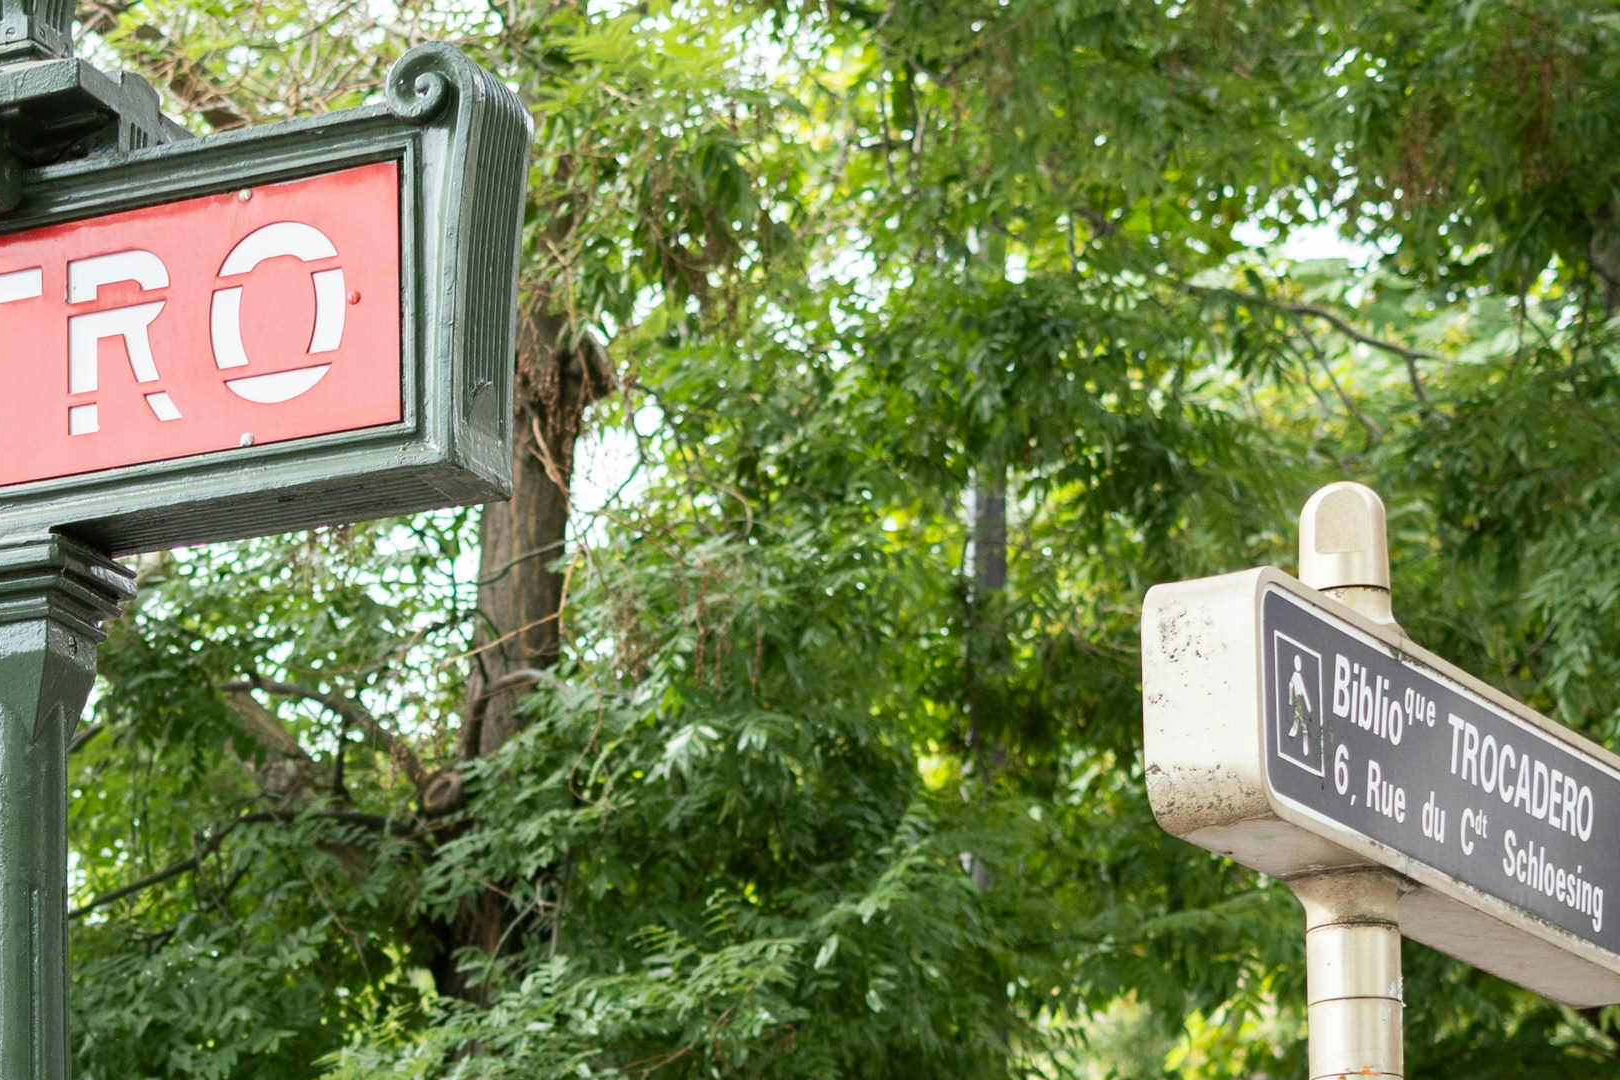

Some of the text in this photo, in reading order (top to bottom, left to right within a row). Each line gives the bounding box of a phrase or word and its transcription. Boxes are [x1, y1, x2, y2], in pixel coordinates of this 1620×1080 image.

[1367, 758, 1406, 824] Rue
[1422, 790, 1445, 844] du
[1503, 829, 1604, 933] Schloesing
[1448, 713, 1594, 843] TROCADERO
